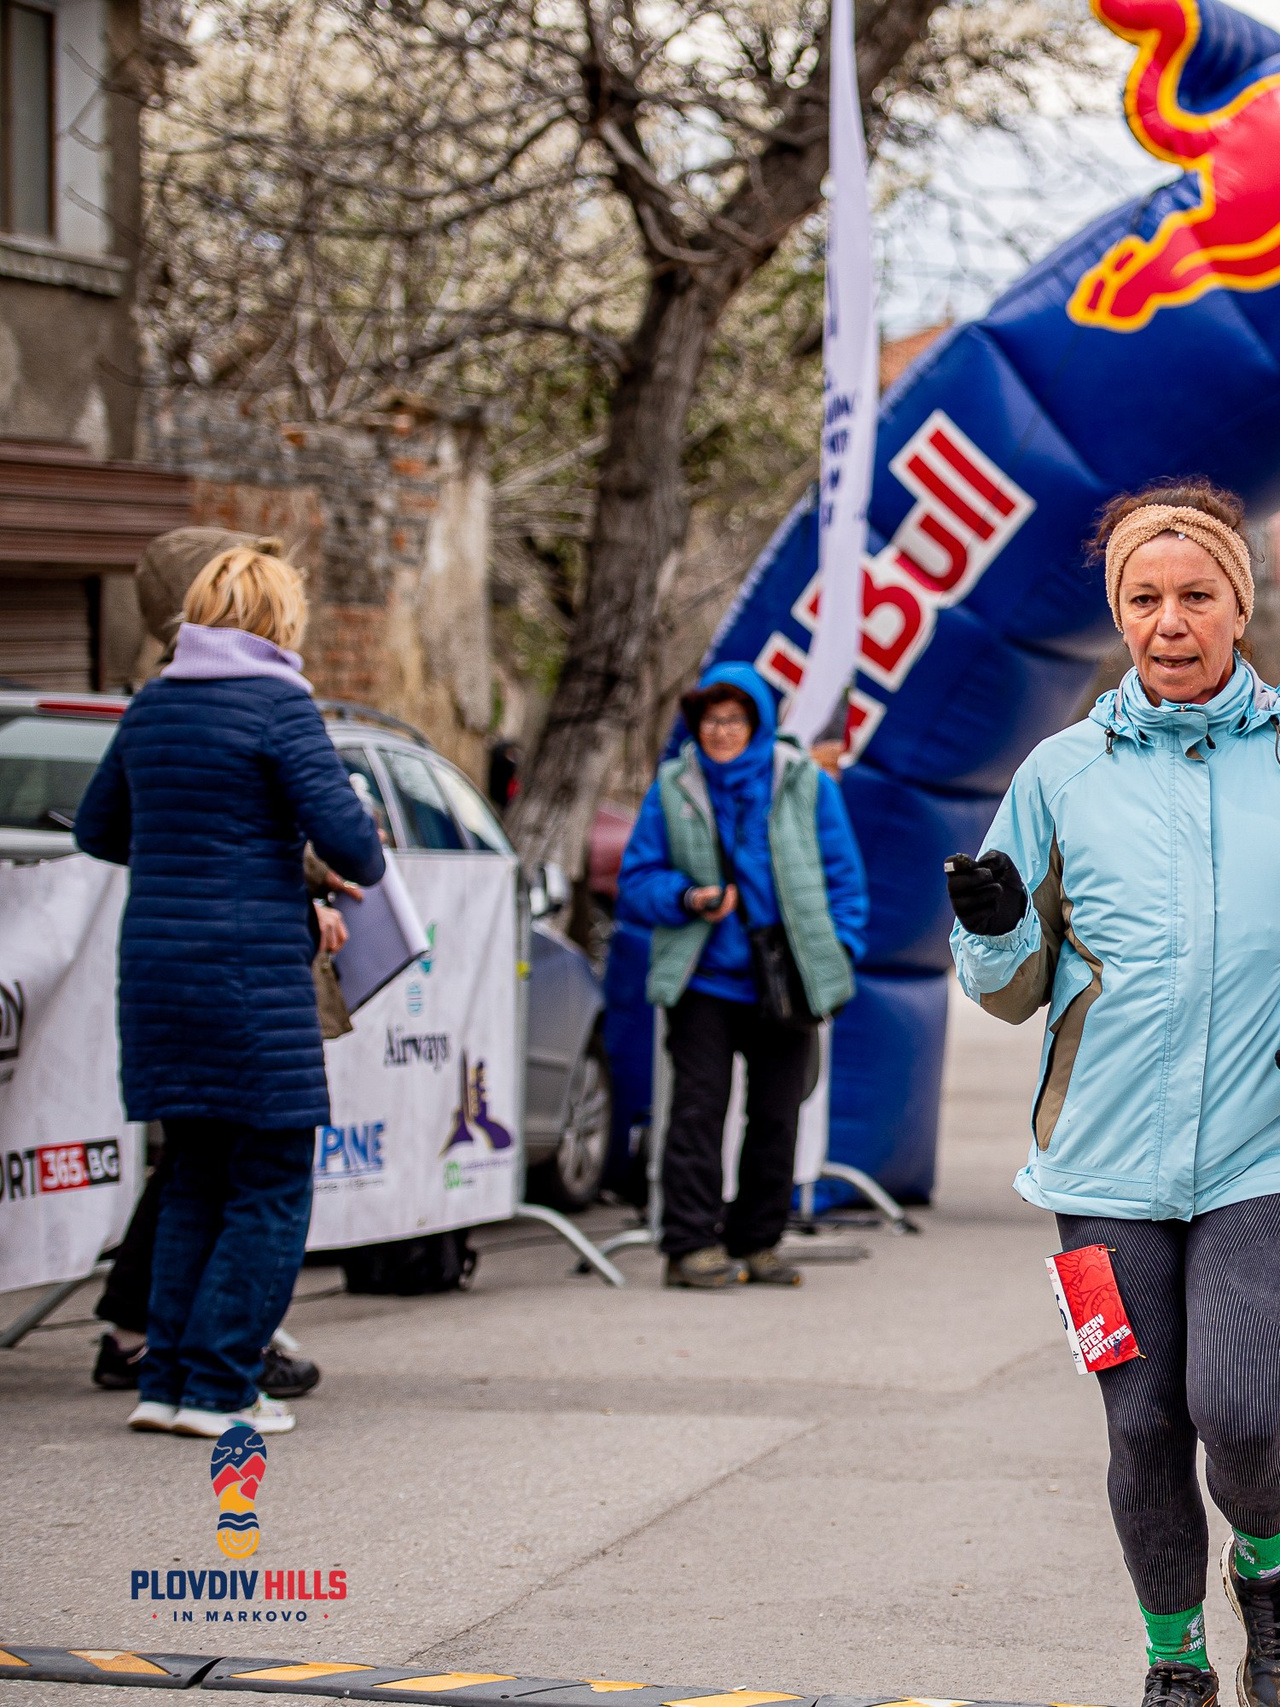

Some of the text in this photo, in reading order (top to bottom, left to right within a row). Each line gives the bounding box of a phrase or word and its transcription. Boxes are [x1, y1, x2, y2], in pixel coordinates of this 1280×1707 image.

[384, 1026, 449, 1073] Airways
[1079, 1328, 1105, 1353] STEP
[1085, 1324, 1132, 1364] MATTERS
